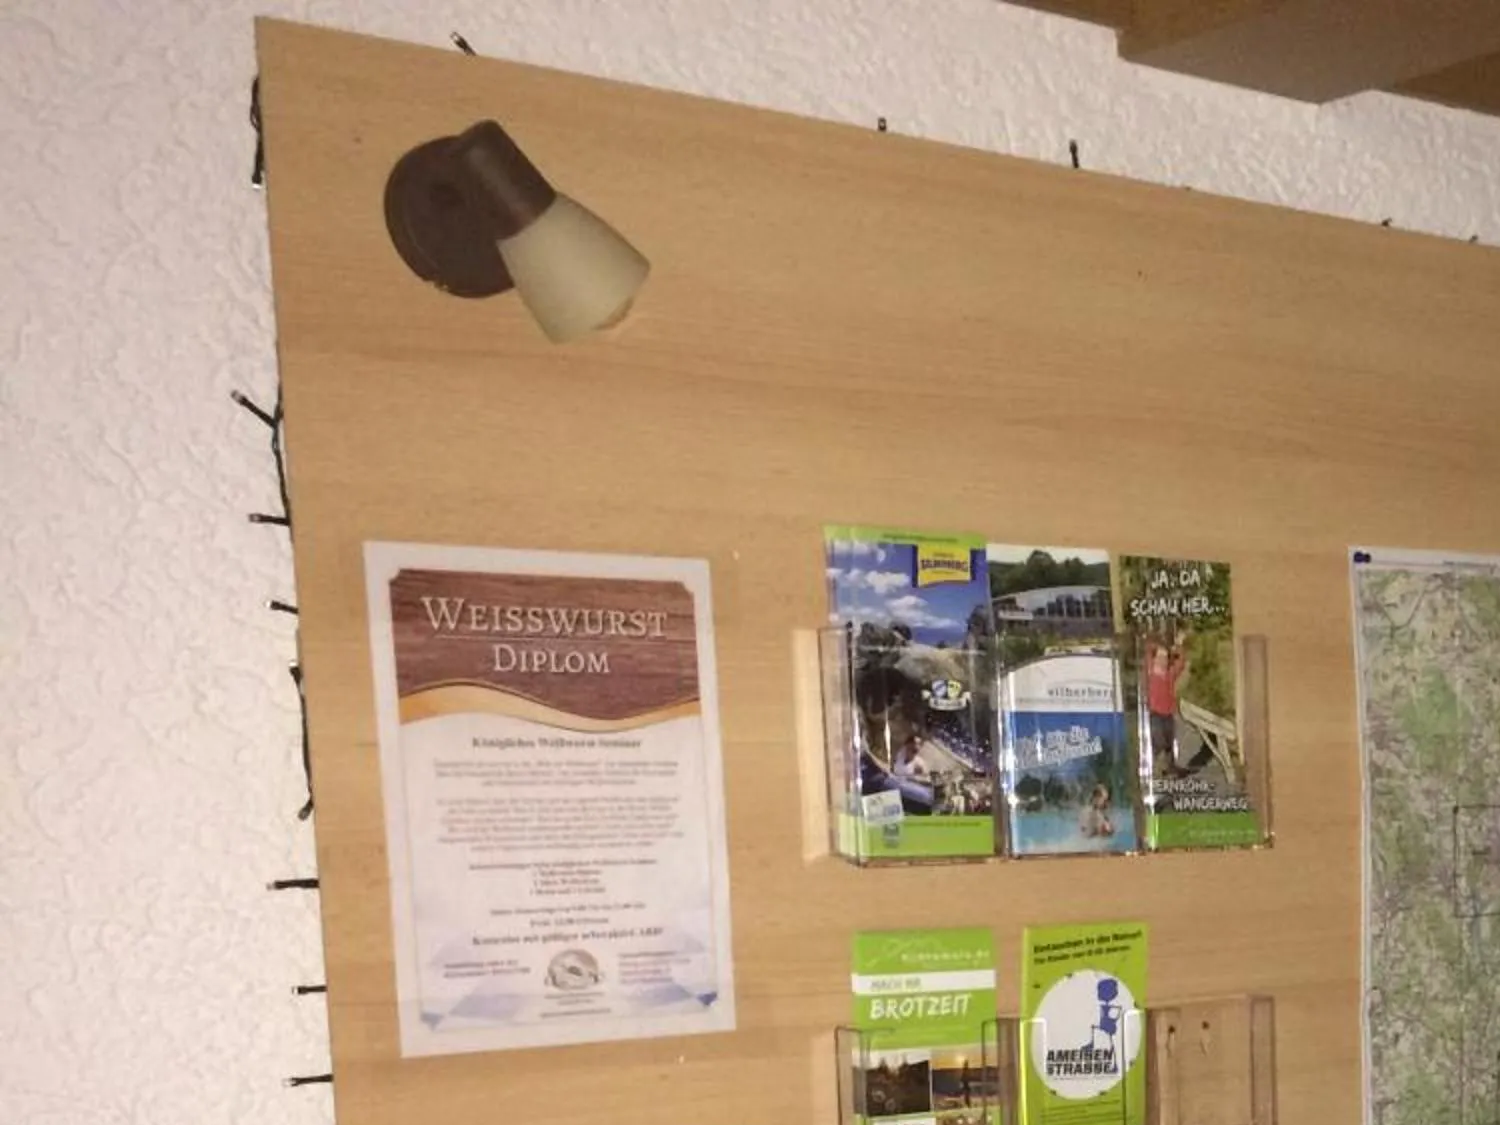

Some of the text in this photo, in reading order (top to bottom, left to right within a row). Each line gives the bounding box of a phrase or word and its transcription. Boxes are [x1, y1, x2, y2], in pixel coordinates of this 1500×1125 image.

[421, 596, 669, 638] WEISSWURST
[1130, 597, 1178, 617] SCHAU
[494, 643, 611, 675] DIPLOM
[869, 992, 973, 1020] BROTZEIT
[1046, 1049, 1113, 1062] AMEISEN
